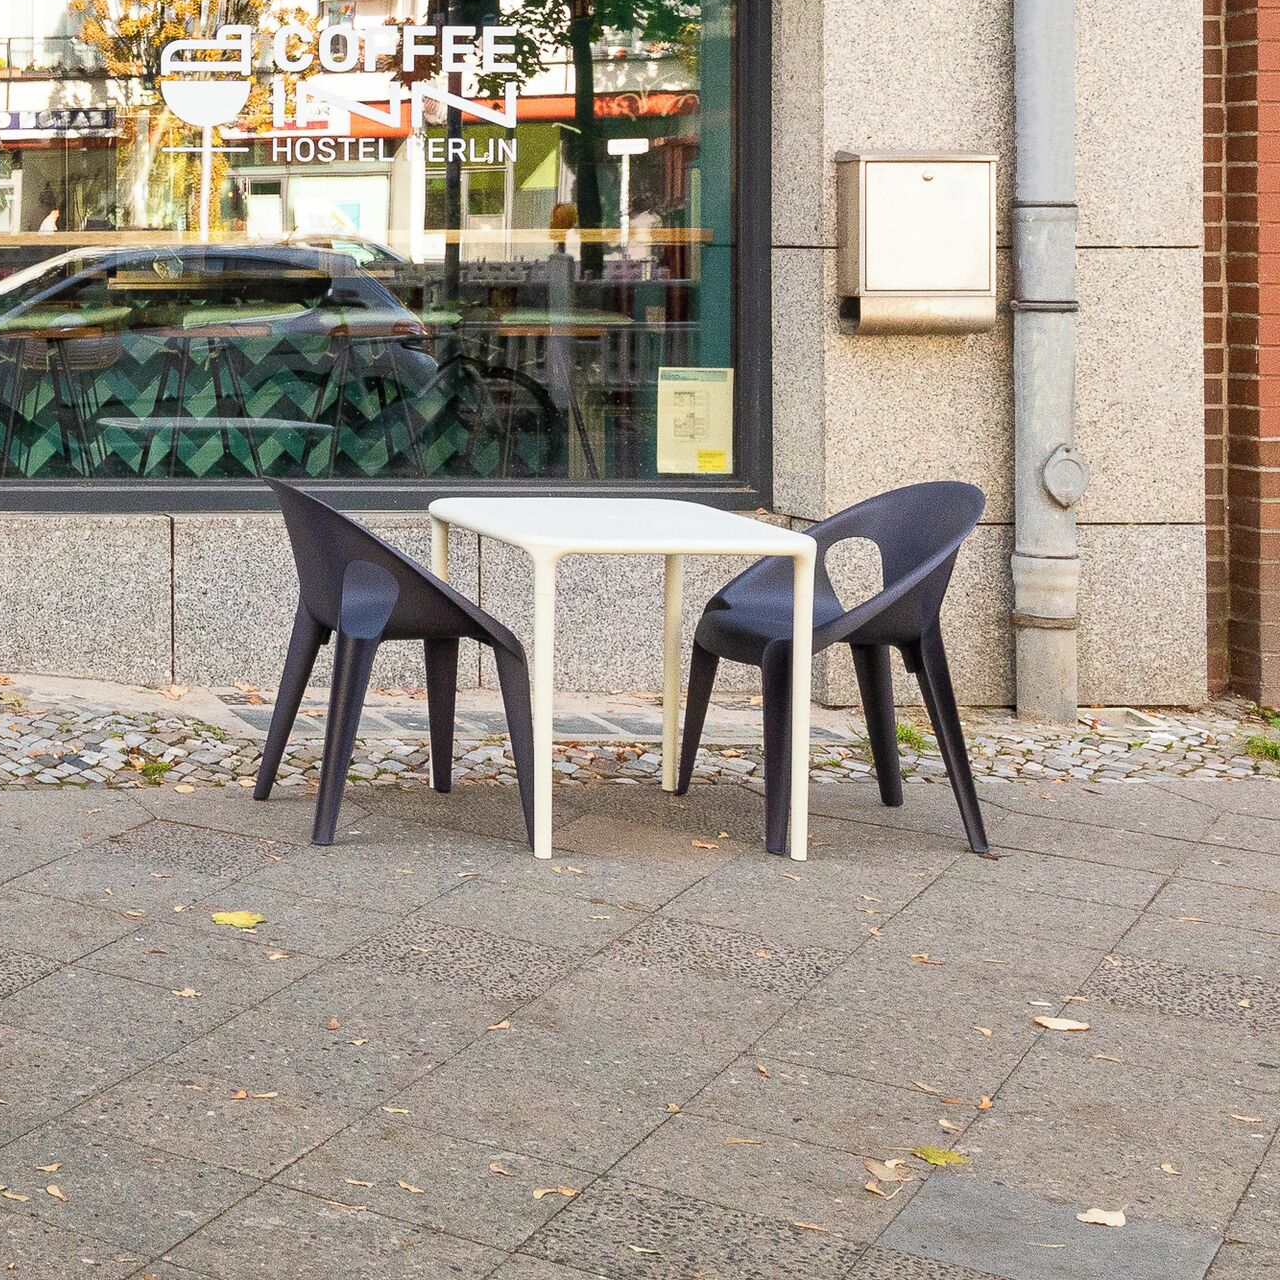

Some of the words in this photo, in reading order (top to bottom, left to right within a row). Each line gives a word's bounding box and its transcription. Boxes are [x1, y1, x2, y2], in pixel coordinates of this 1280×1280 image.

[273, 25, 518, 73] COFFEE
[273, 80, 518, 128] INN
[272, 137, 395, 163] HOSTEL
